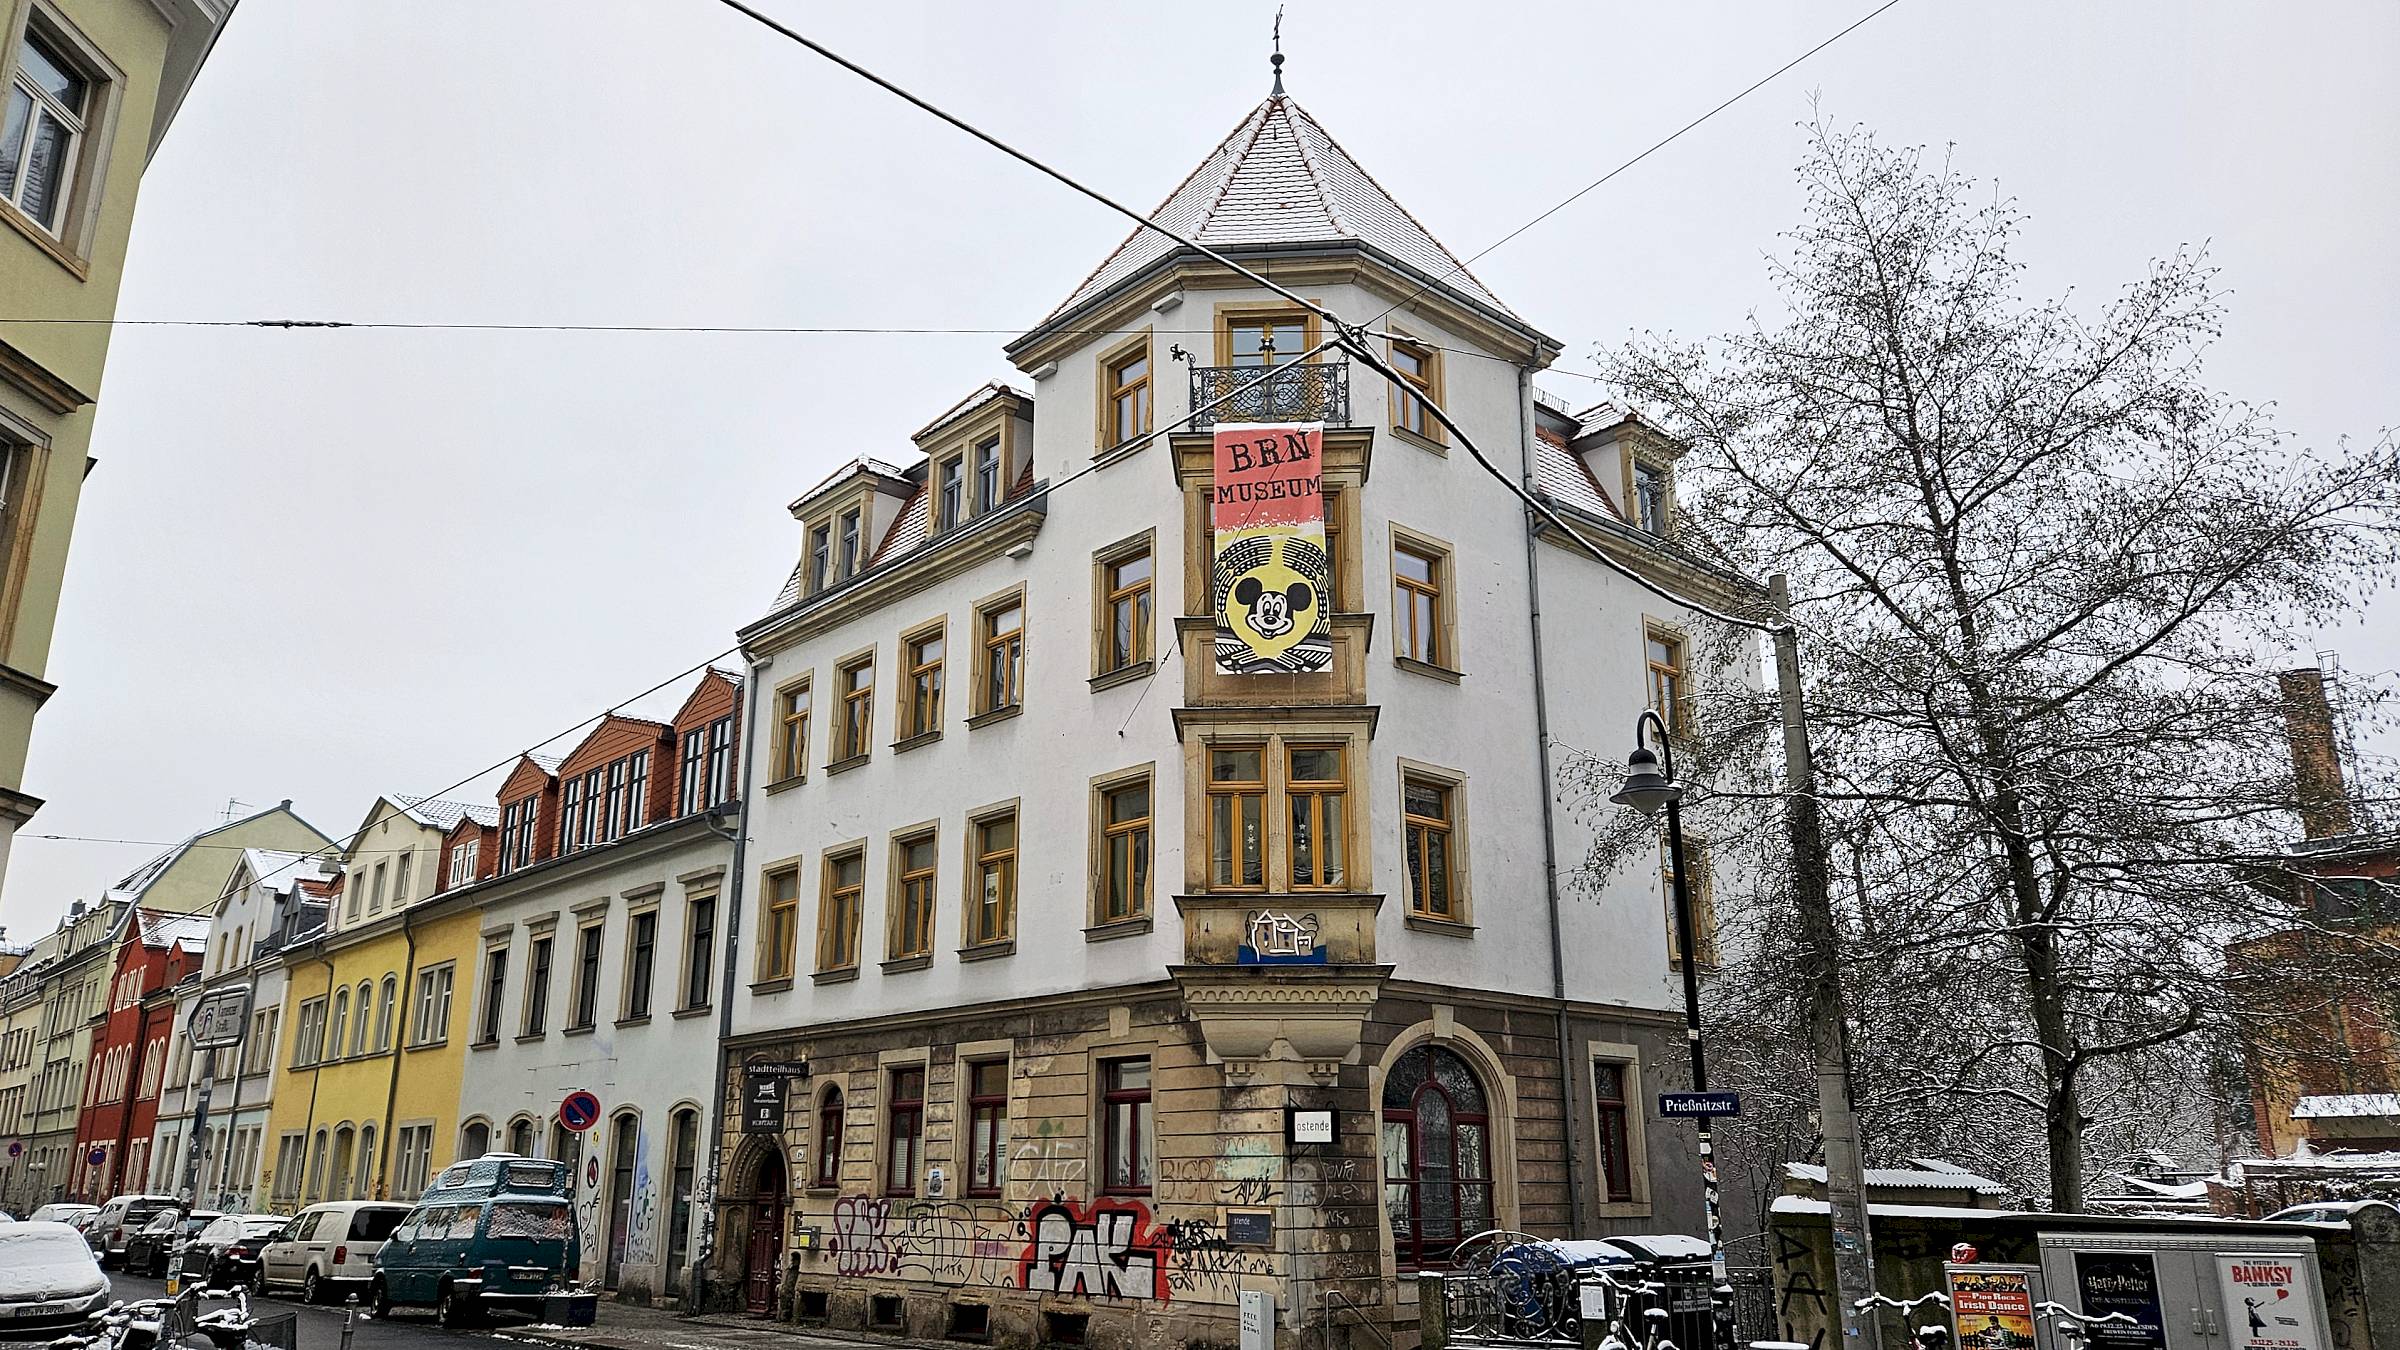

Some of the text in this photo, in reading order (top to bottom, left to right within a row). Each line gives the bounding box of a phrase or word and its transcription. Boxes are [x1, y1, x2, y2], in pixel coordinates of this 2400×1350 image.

[1225, 431, 1313, 472] BRN
[1216, 475, 1321, 504] MUSEUM
[749, 1064, 800, 1073] stadtteilhaus
[1665, 1098, 1734, 1112] Prießnitzstr.
[1296, 1119, 1330, 1132] ostende
[2231, 1265, 2293, 1284] BANKSY
[2087, 1275, 2149, 1293] Harry Potter
[1958, 1300, 2025, 1311] Irish Dance
